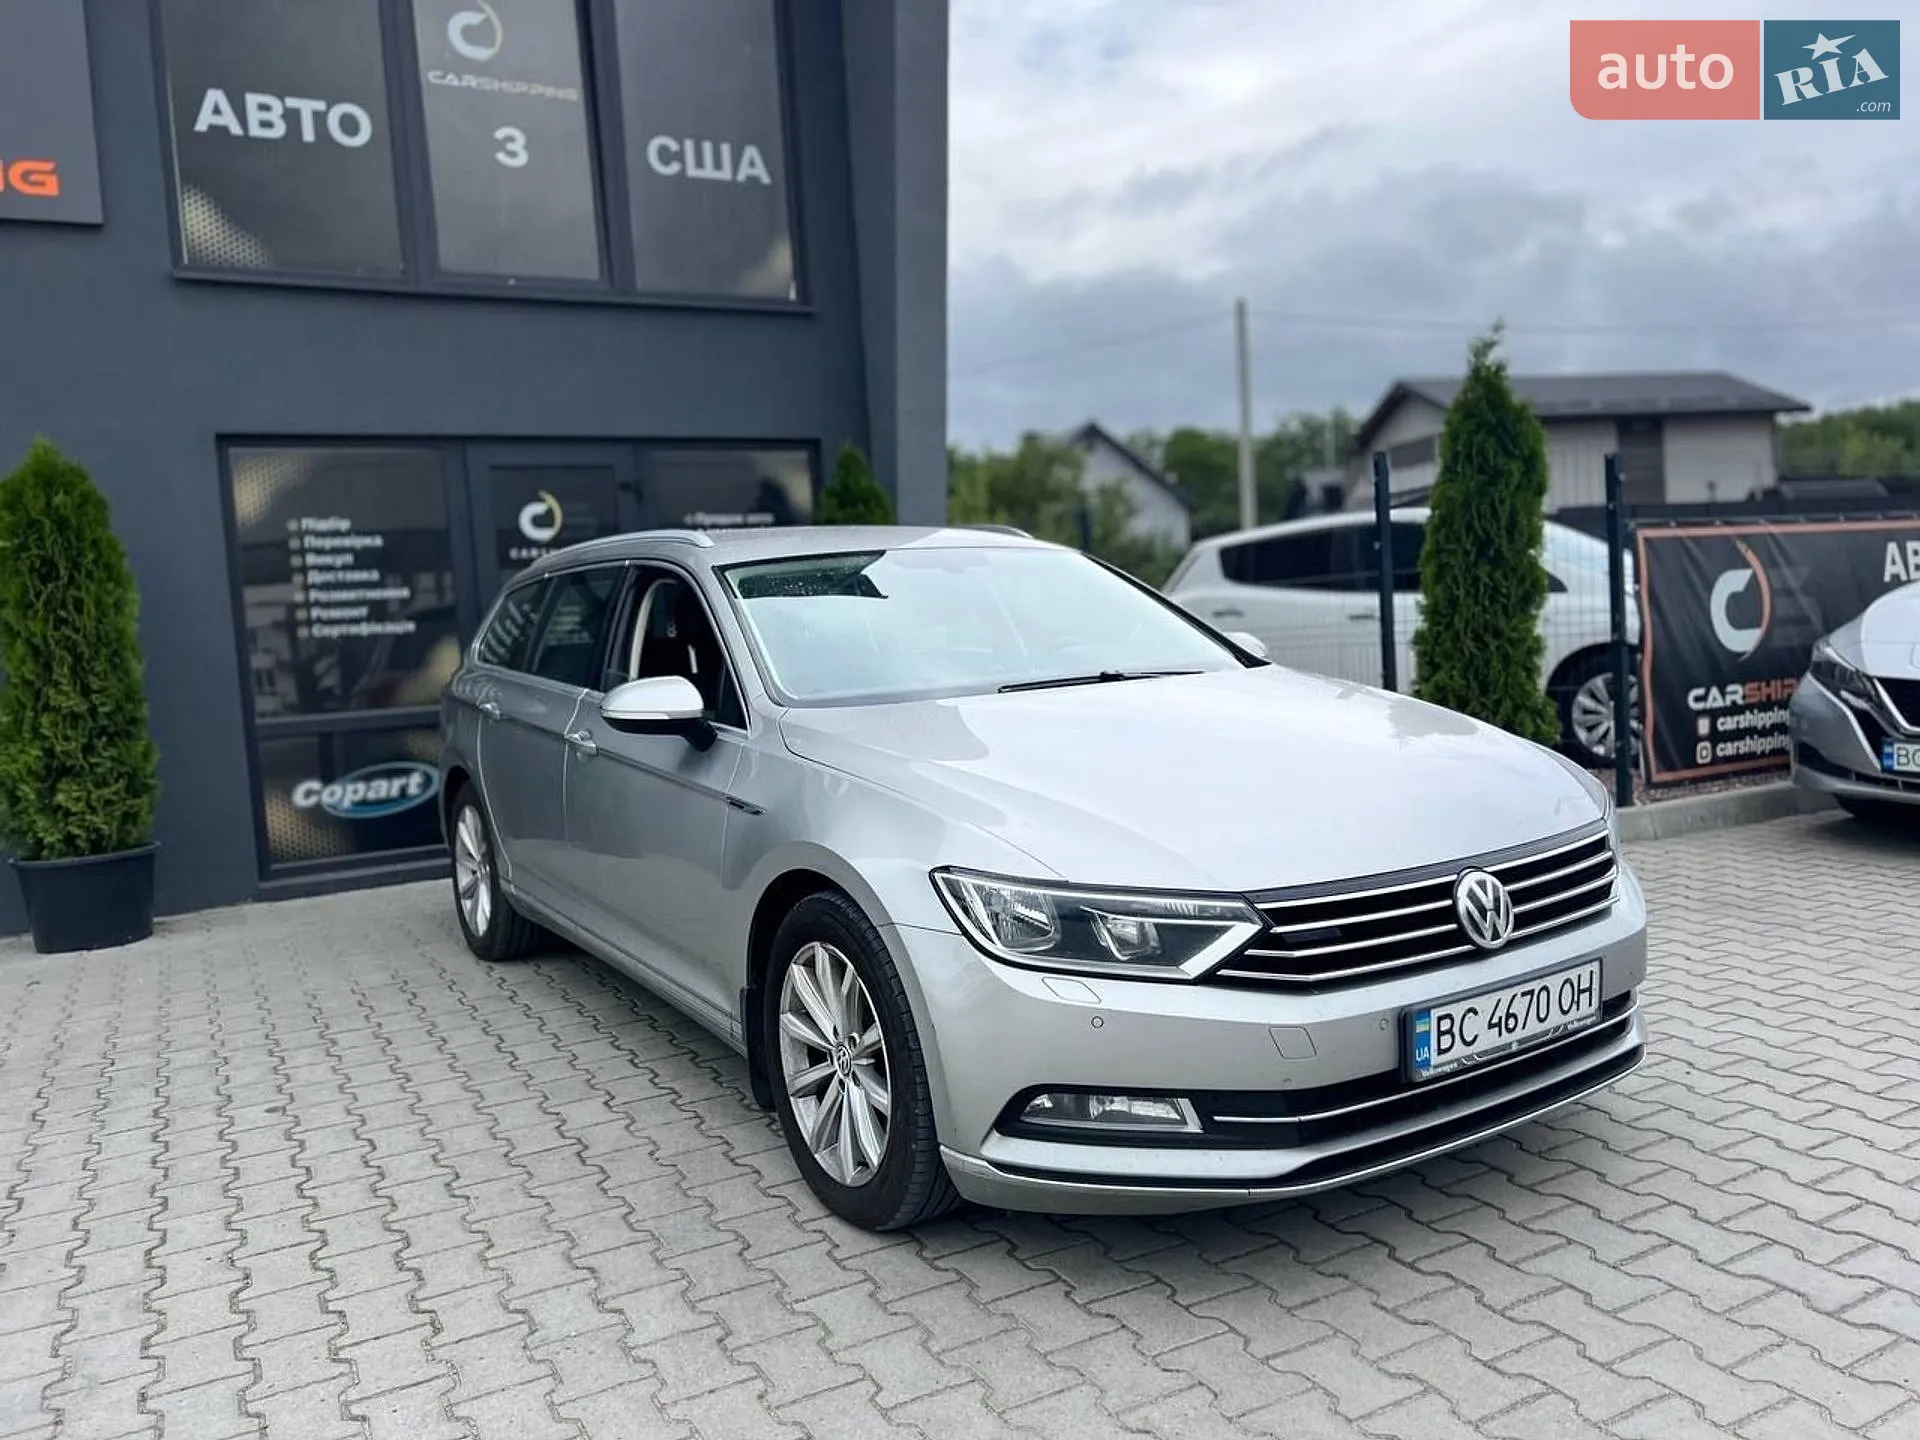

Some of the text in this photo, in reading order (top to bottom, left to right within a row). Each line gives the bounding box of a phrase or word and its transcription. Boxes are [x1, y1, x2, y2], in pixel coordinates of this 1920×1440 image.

[427, 69, 578, 102] CARSHIPPING
[194, 88, 372, 148] АВТО
[647, 135, 772, 186] США
[0, 159, 60, 197] G
[291, 772, 423, 811] Copart
[1437, 970, 1593, 1056] BC 4670 OH
[1415, 1046, 1430, 1062] UA
